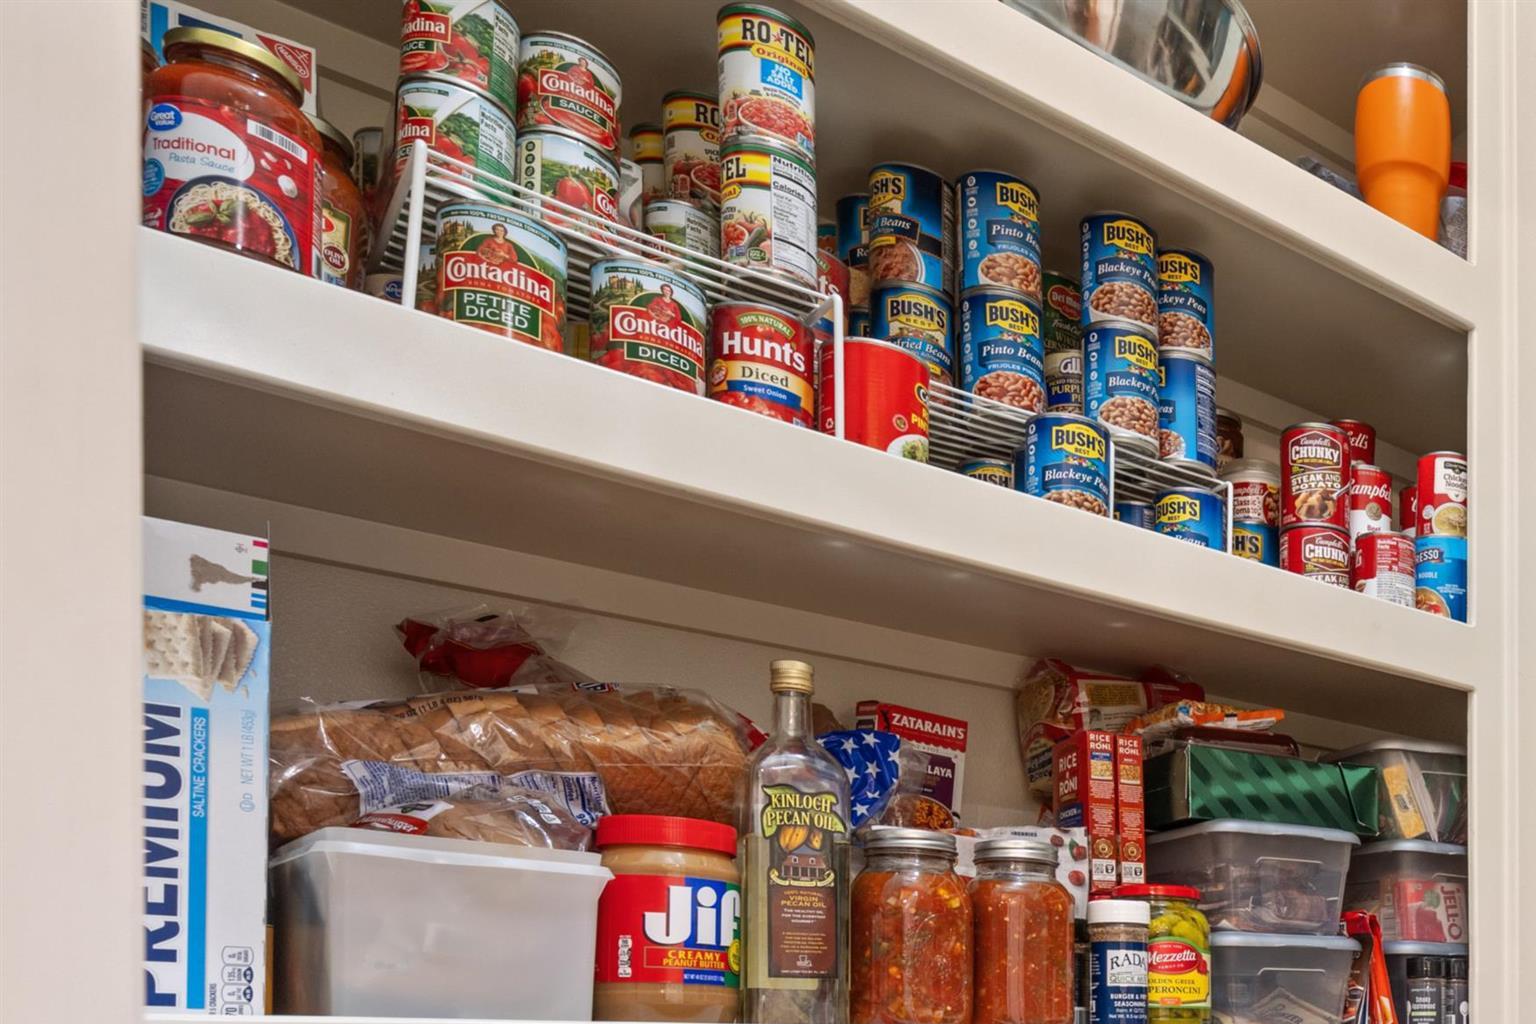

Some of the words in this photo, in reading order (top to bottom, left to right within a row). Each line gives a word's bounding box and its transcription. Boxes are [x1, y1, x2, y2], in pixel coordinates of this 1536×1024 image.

[755, 46, 808, 76] Original
[541, 72, 614, 117] Contadina
[559, 98, 602, 122] SAUCE
[153, 137, 236, 161] Traditional
[169, 152, 196, 165] Pasta
[200, 157, 236, 173] Sauce
[880, 216, 911, 230] Beans
[992, 224, 1023, 240] Pinto
[1106, 224, 1153, 254] BUSH'S
[446, 256, 551, 302] Contadina
[1097, 263, 1142, 277] Blackeye
[463, 292, 532, 318] PETITE
[889, 300, 946, 330] BUSH'S
[465, 304, 529, 329] DICED
[758, 316, 791, 337] NATURAL
[989, 303, 1038, 339] BUSH'S
[614, 310, 704, 358] Contadina
[639, 346, 690, 371] DICED
[982, 342, 1015, 357] Pinto
[741, 366, 790, 388] Diced
[1108, 376, 1151, 392] Blackeye
[765, 389, 787, 400] Onion
[1054, 429, 1105, 458] BUSH'S
[1291, 446, 1339, 461] CHUNKY
[1044, 469, 1092, 486] Blackeye
[1291, 474, 1324, 486] STEAK
[1291, 481, 1342, 491] POTATO
[1156, 500, 1199, 518] BUSH'S
[1305, 543, 1349, 566] CHUNKY
[892, 712, 967, 740] ZATARAIN'S
[192, 716, 207, 774] CRACKERS
[1089, 733, 1112, 744] RICE
[1118, 738, 1140, 749] RICE
[1058, 751, 1078, 772] RICE
[192, 776, 206, 818] SALTINE
[1058, 776, 1079, 798] RONI
[771, 793, 833, 814] KINLOCH
[767, 811, 810, 827] PECAN
[814, 813, 836, 832] OIL
[643, 884, 741, 947] Jif
[1440, 885, 1463, 941] JELL-O
[662, 958, 697, 968] PEANUT
[699, 959, 725, 970] BUTTER
[667, 950, 722, 961] CREAMY
[1148, 950, 1197, 966] Mezzetta
